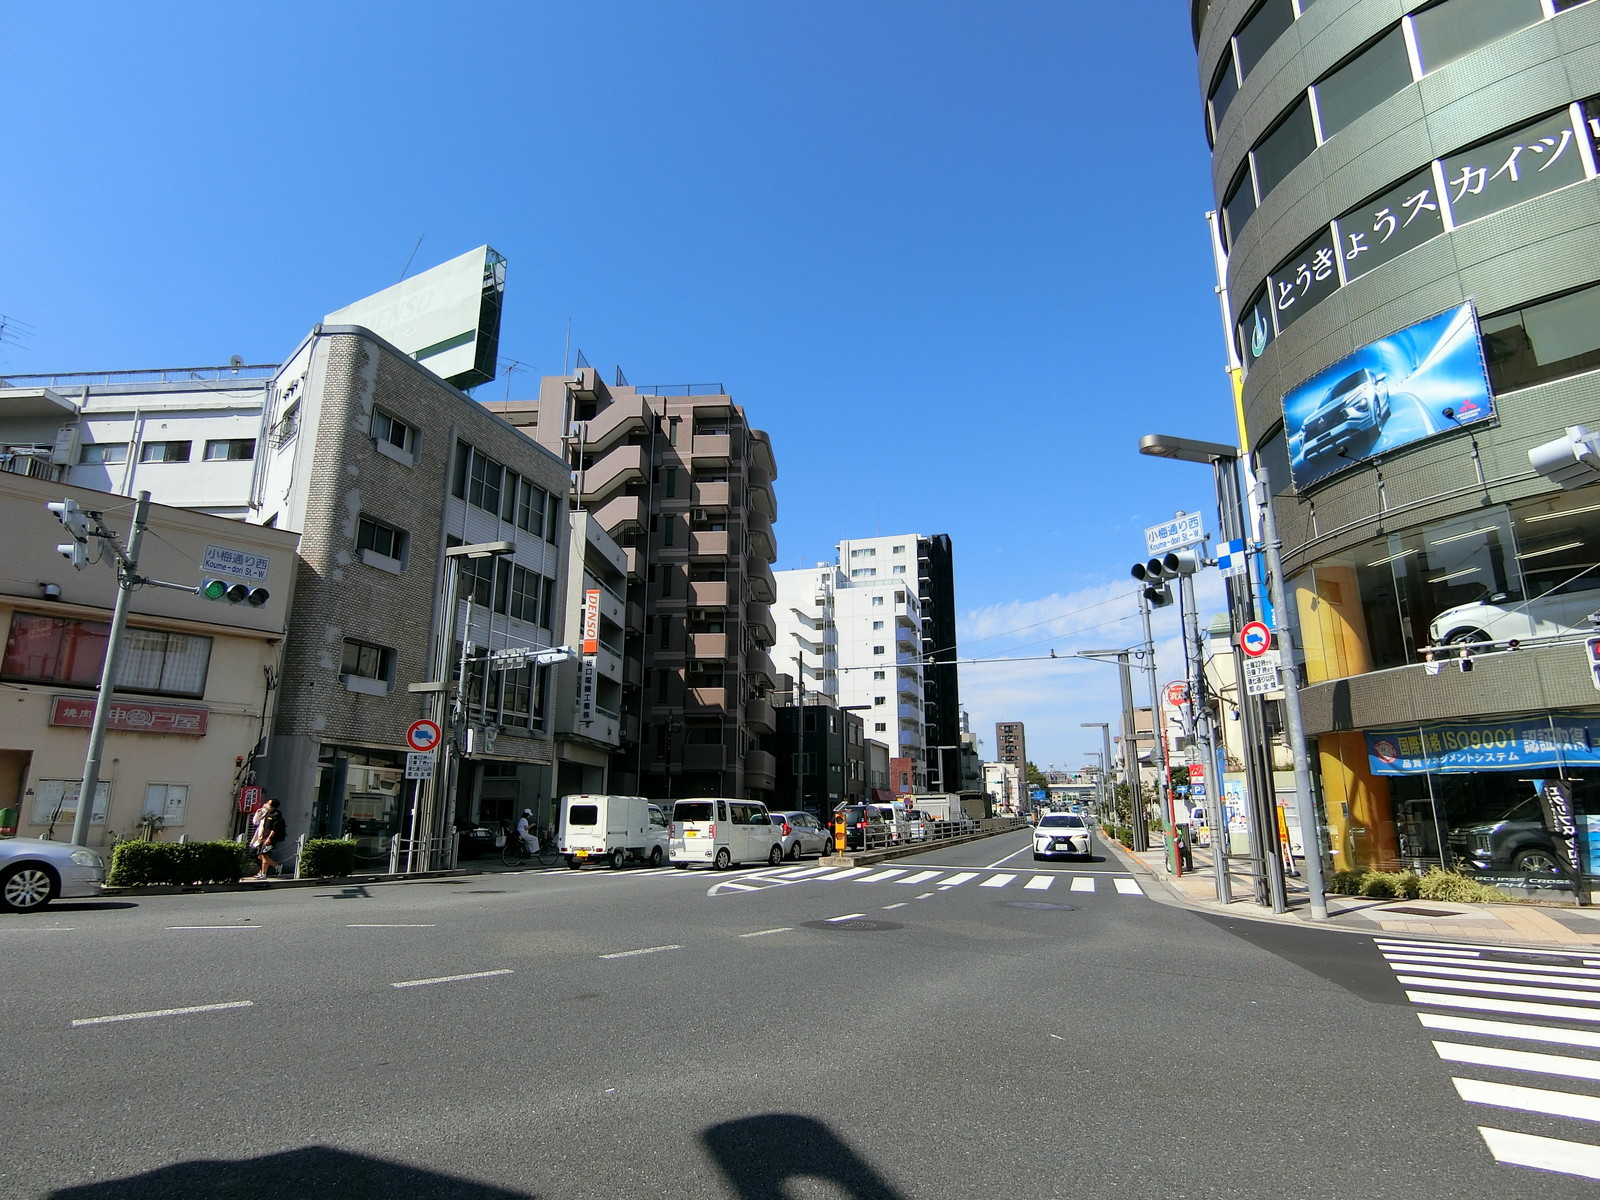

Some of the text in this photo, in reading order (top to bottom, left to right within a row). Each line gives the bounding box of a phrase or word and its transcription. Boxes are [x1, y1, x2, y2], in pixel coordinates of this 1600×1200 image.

[1148, 517, 1199, 543] 小梅通り西
[1149, 534, 1181, 551] Koume-dori
[205, 559, 244, 574] Koume-dori
[207, 549, 268, 569] 小梅通り西
[586, 594, 597, 638] DENSO
[63, 707, 92, 719] 焼肉
[1442, 728, 1517, 750] ISO9001
